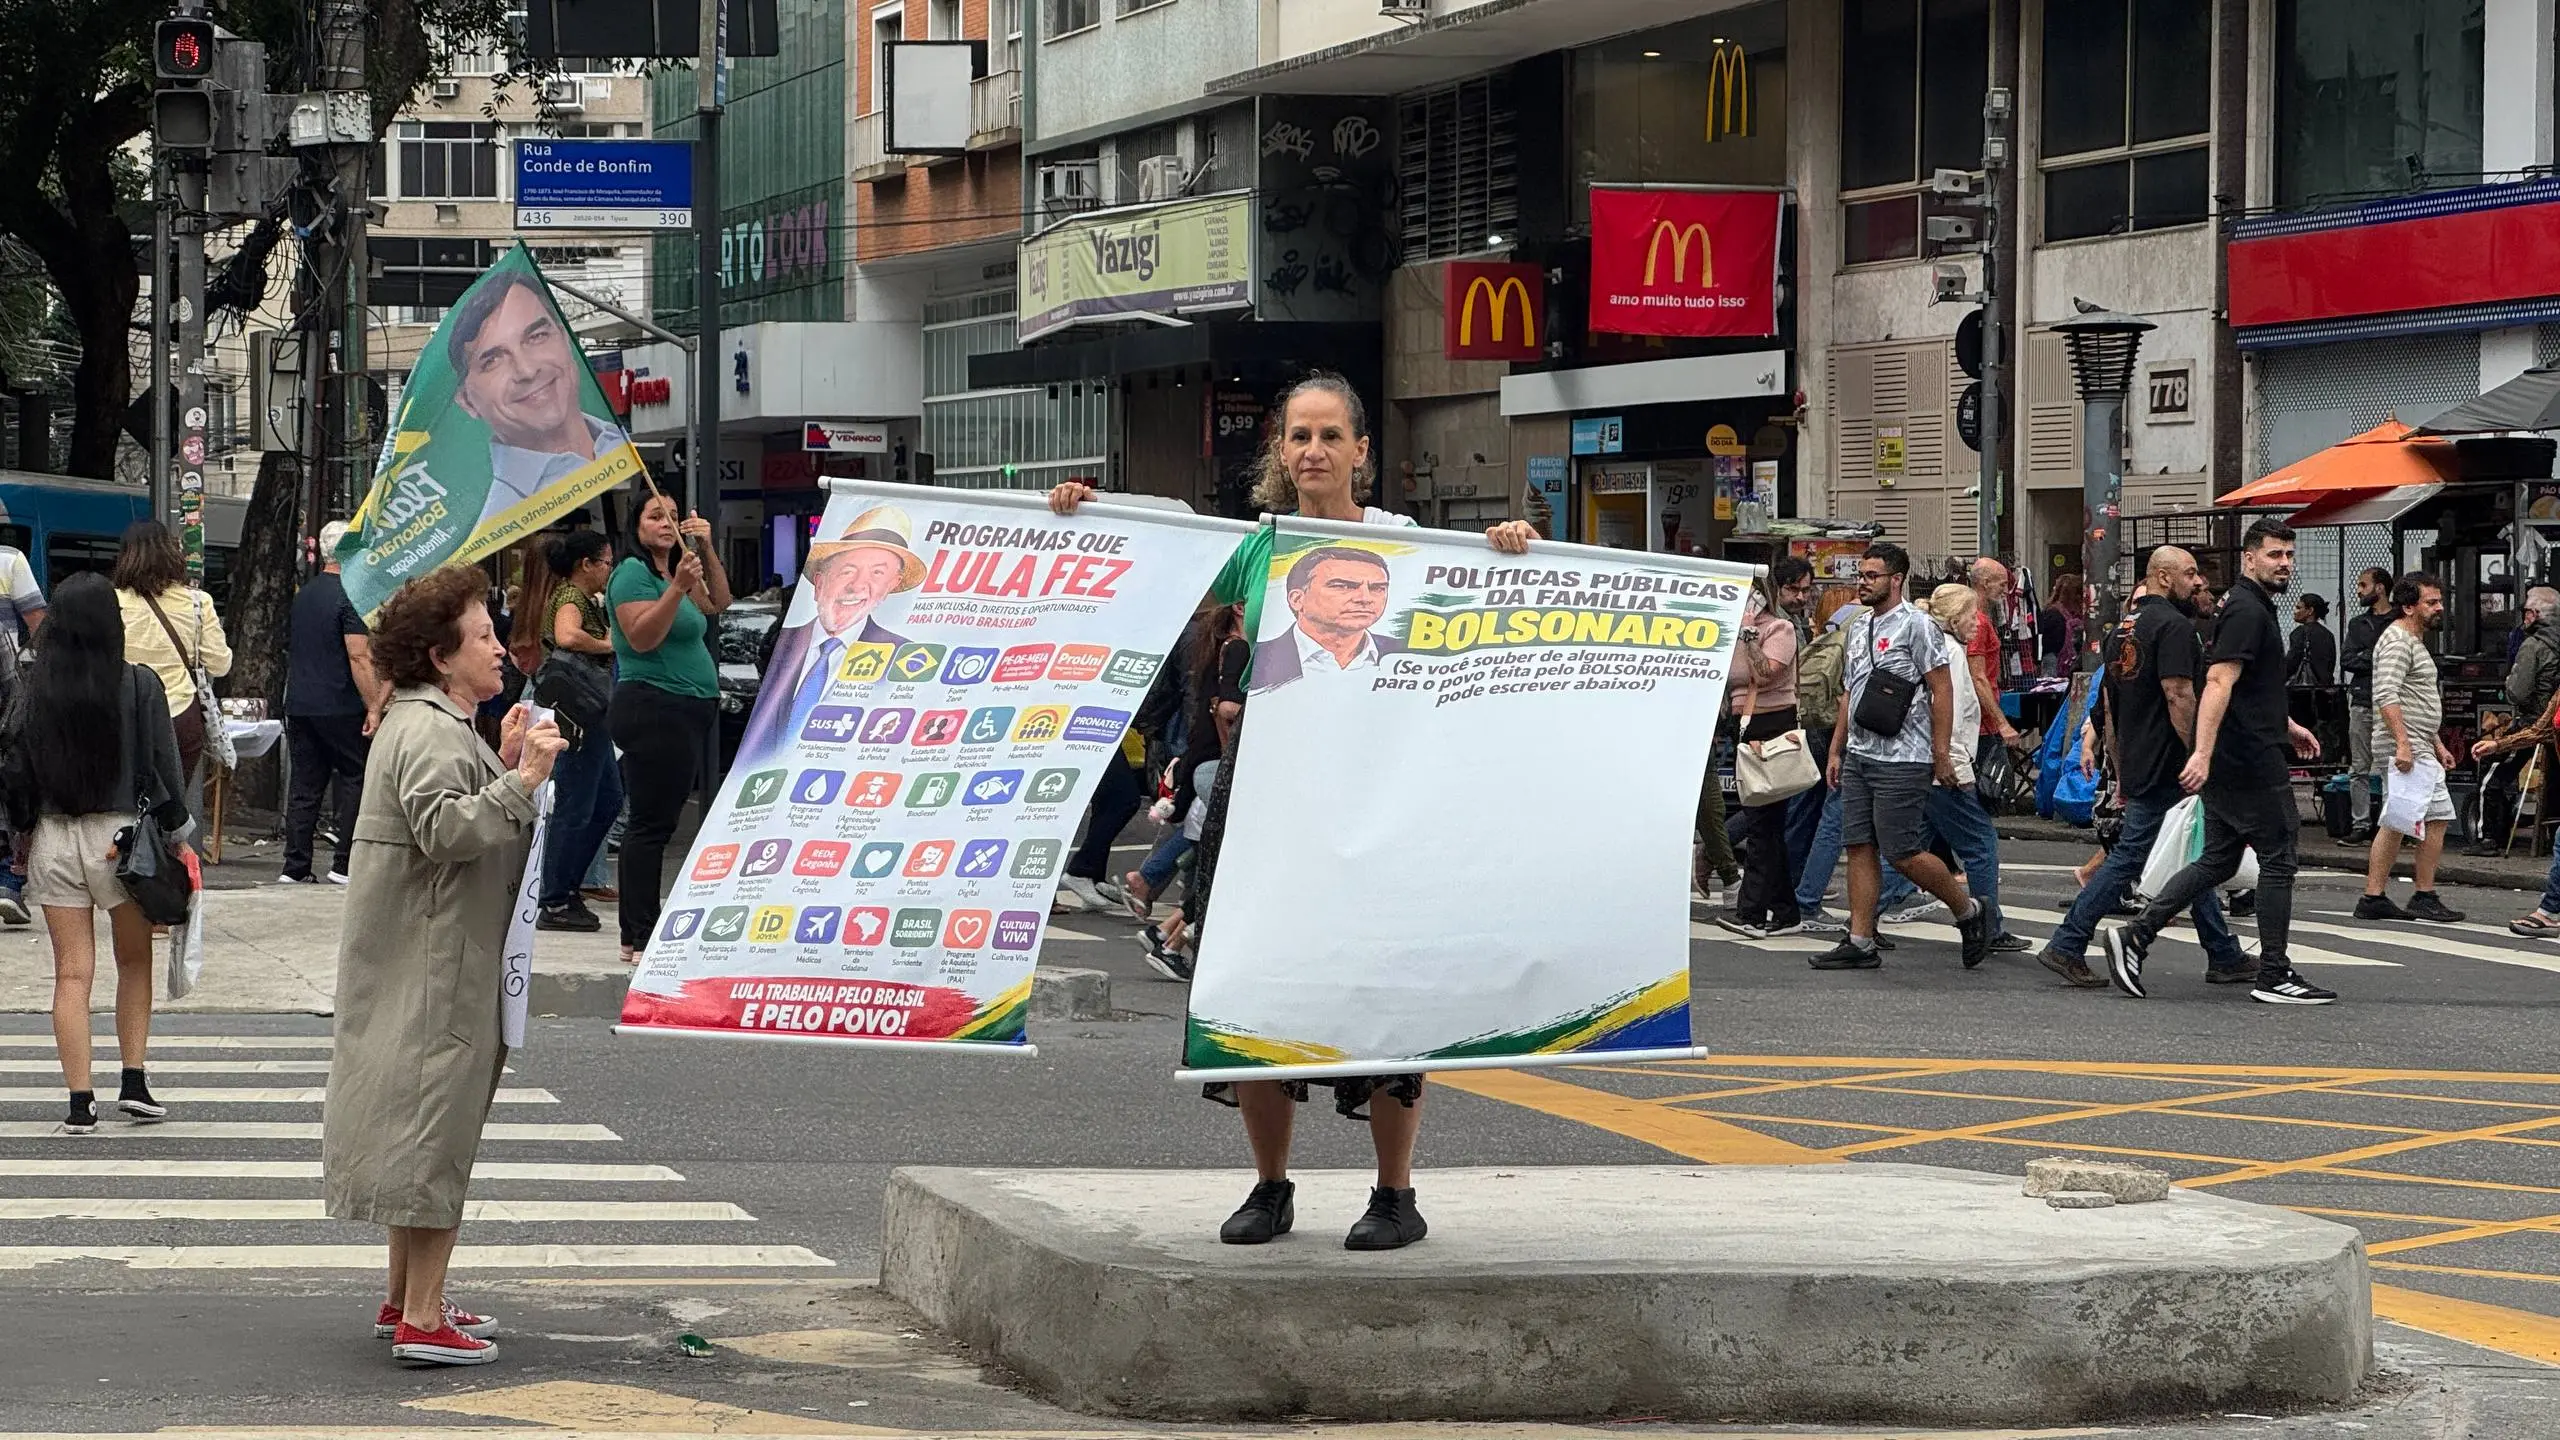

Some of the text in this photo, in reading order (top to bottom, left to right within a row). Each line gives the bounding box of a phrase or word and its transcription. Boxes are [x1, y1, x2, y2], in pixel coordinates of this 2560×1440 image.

[524, 143, 552, 156] Rua
[524, 159, 652, 173] Conde de Bonfim
[523, 212, 551, 224] 436
[660, 213, 687, 225] 390
[1610, 294, 1745, 308] amo muito tudo isso
[2151, 377, 2187, 408] 778
[1219, 415, 1253, 435] 9,99
[836, 434, 882, 442] VENANCIO
[925, 520, 1129, 555] PROGRAMAS QUE
[921, 550, 1134, 598] LULA FEZ
[1425, 565, 1740, 601] POLÍTICAS PÚBLICAS
[1484, 589, 1658, 611] DA FAMÍLIA
[913, 601, 1099, 615] MAIS INCLUSÃO, DIREITOS E OPORTUNIDADES
[906, 614, 1037, 629] PARA O POVO BRASILEIRO
[1407, 610, 1720, 651] BOLSONARO
[1002, 652, 1049, 665] PÉ-DE-MEIA
[1058, 653, 1105, 667] ProUni
[1393, 649, 1711, 676] (Se você souber de alguma política
[1372, 662, 1725, 693] para o povo feita pelo BOLSONARISMO,
[835, 683, 857, 691] Minha
[1053, 683, 1079, 691] ProUni
[1112, 688, 1130, 696] FIES
[1435, 676, 1657, 708] pode escrever abaixo!)
[832, 690, 869, 699] Minha Vida
[810, 719, 833, 730] SUS
[1073, 716, 1124, 730] PRONATEC
[1065, 744, 1106, 753] PRONATEC
[1024, 805, 1056, 813] Florestas
[812, 849, 836, 858] REDE
[1029, 845, 1046, 855] Luz
[800, 858, 839, 870] Cegonha
[1025, 856, 1047, 867] para
[1019, 865, 1046, 876] Todos
[967, 880, 976, 888] TV
[1012, 881, 1041, 890] Luz para
[958, 889, 980, 897] Digital
[1013, 890, 1033, 898] Todos
[759, 911, 783, 932] iD
[902, 919, 932, 929] BRASIL
[1000, 920, 1036, 930] CULTURA
[755, 933, 778, 941] JOVEM
[894, 929, 935, 938] SORRIDENTE
[1002, 931, 1029, 944] VIVA
[843, 949, 874, 957] Territórios
[946, 951, 975, 960] Programa
[992, 953, 1028, 962] Cultura Viva
[796, 955, 821, 964] Médicos
[947, 976, 965, 984] (PAA)
[730, 983, 925, 1008] LULA TRABALHA PELO BRASIL
[740, 1004, 910, 1035] E PELO POVO!
